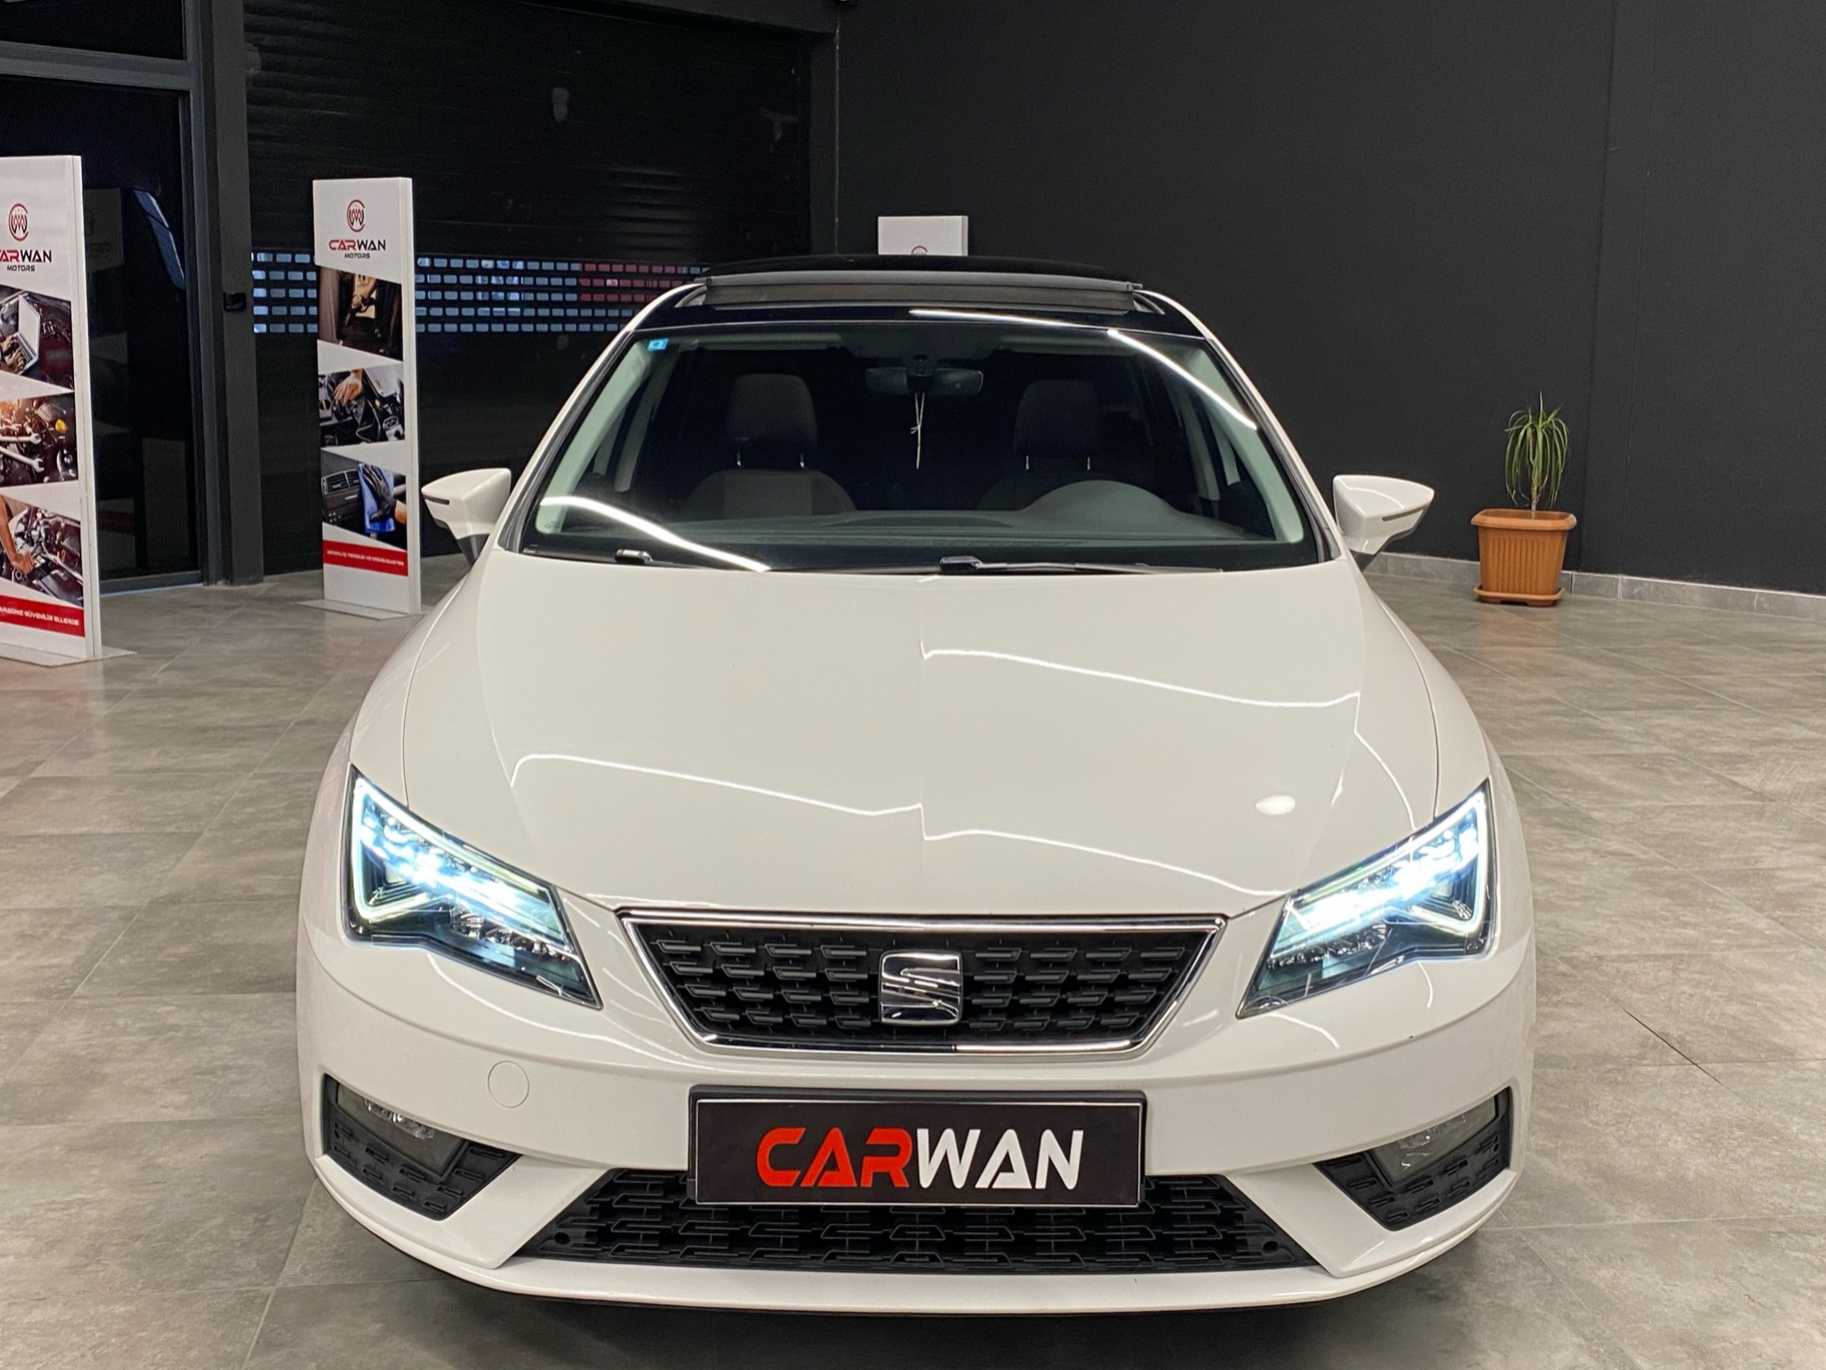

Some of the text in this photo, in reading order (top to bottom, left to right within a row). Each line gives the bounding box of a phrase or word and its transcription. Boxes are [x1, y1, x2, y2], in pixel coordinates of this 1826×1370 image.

[328, 239, 386, 251] CARWAN
[0, 249, 52, 263] ARWAN
[344, 252, 371, 260] MOTORS
[7, 264, 36, 272] MOTORS
[756, 1126, 1084, 1190] CARWAN
